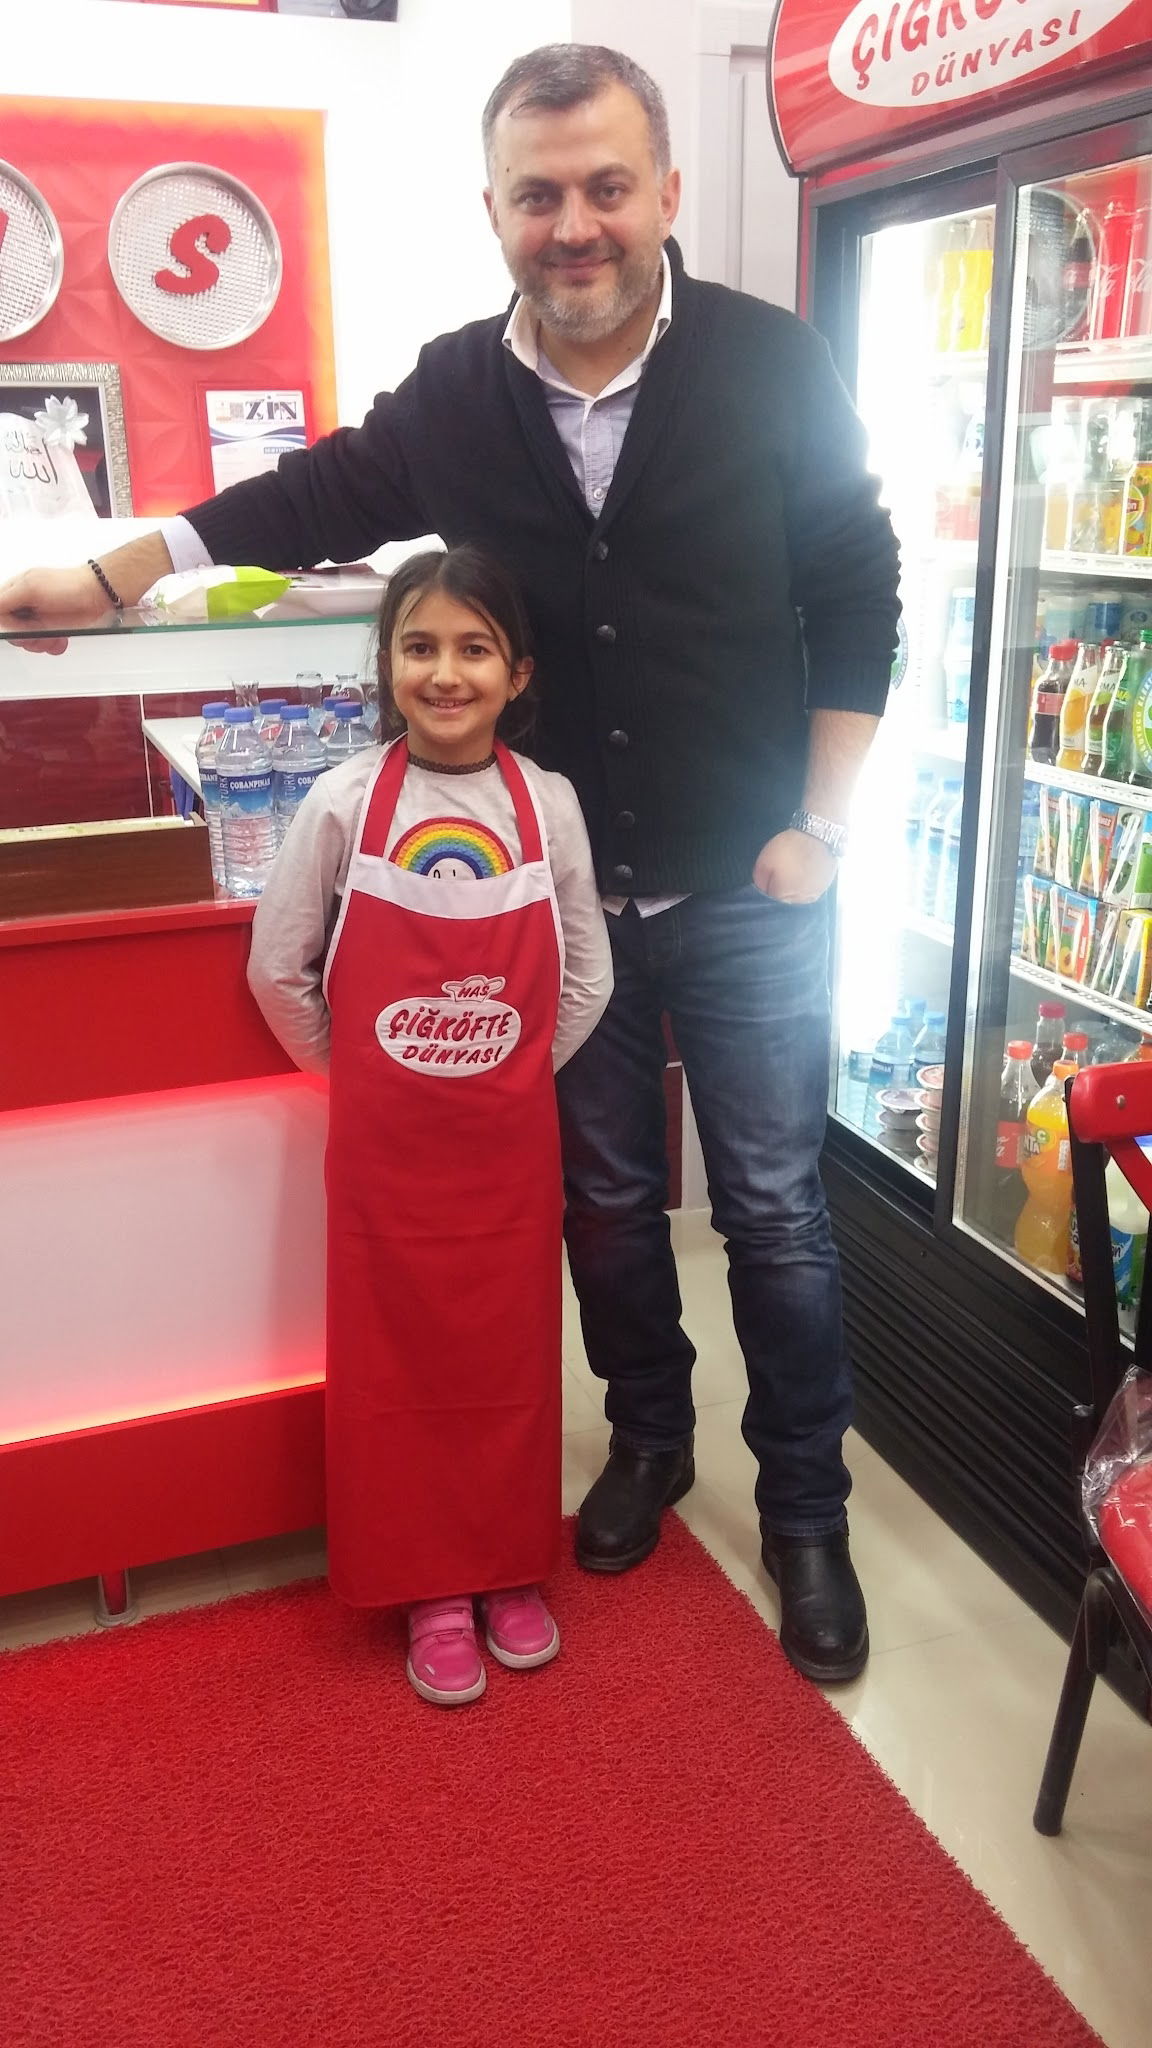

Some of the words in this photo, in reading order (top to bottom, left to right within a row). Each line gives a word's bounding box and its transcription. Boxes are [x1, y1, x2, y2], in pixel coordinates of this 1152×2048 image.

[911, 9, 1081, 97] DÜNYASI
[153, 213, 232, 295] S
[457, 985, 490, 998] HAS
[388, 1005, 513, 1042] ÇİĞKÖFTE
[402, 1044, 503, 1065] DÜNYASI
